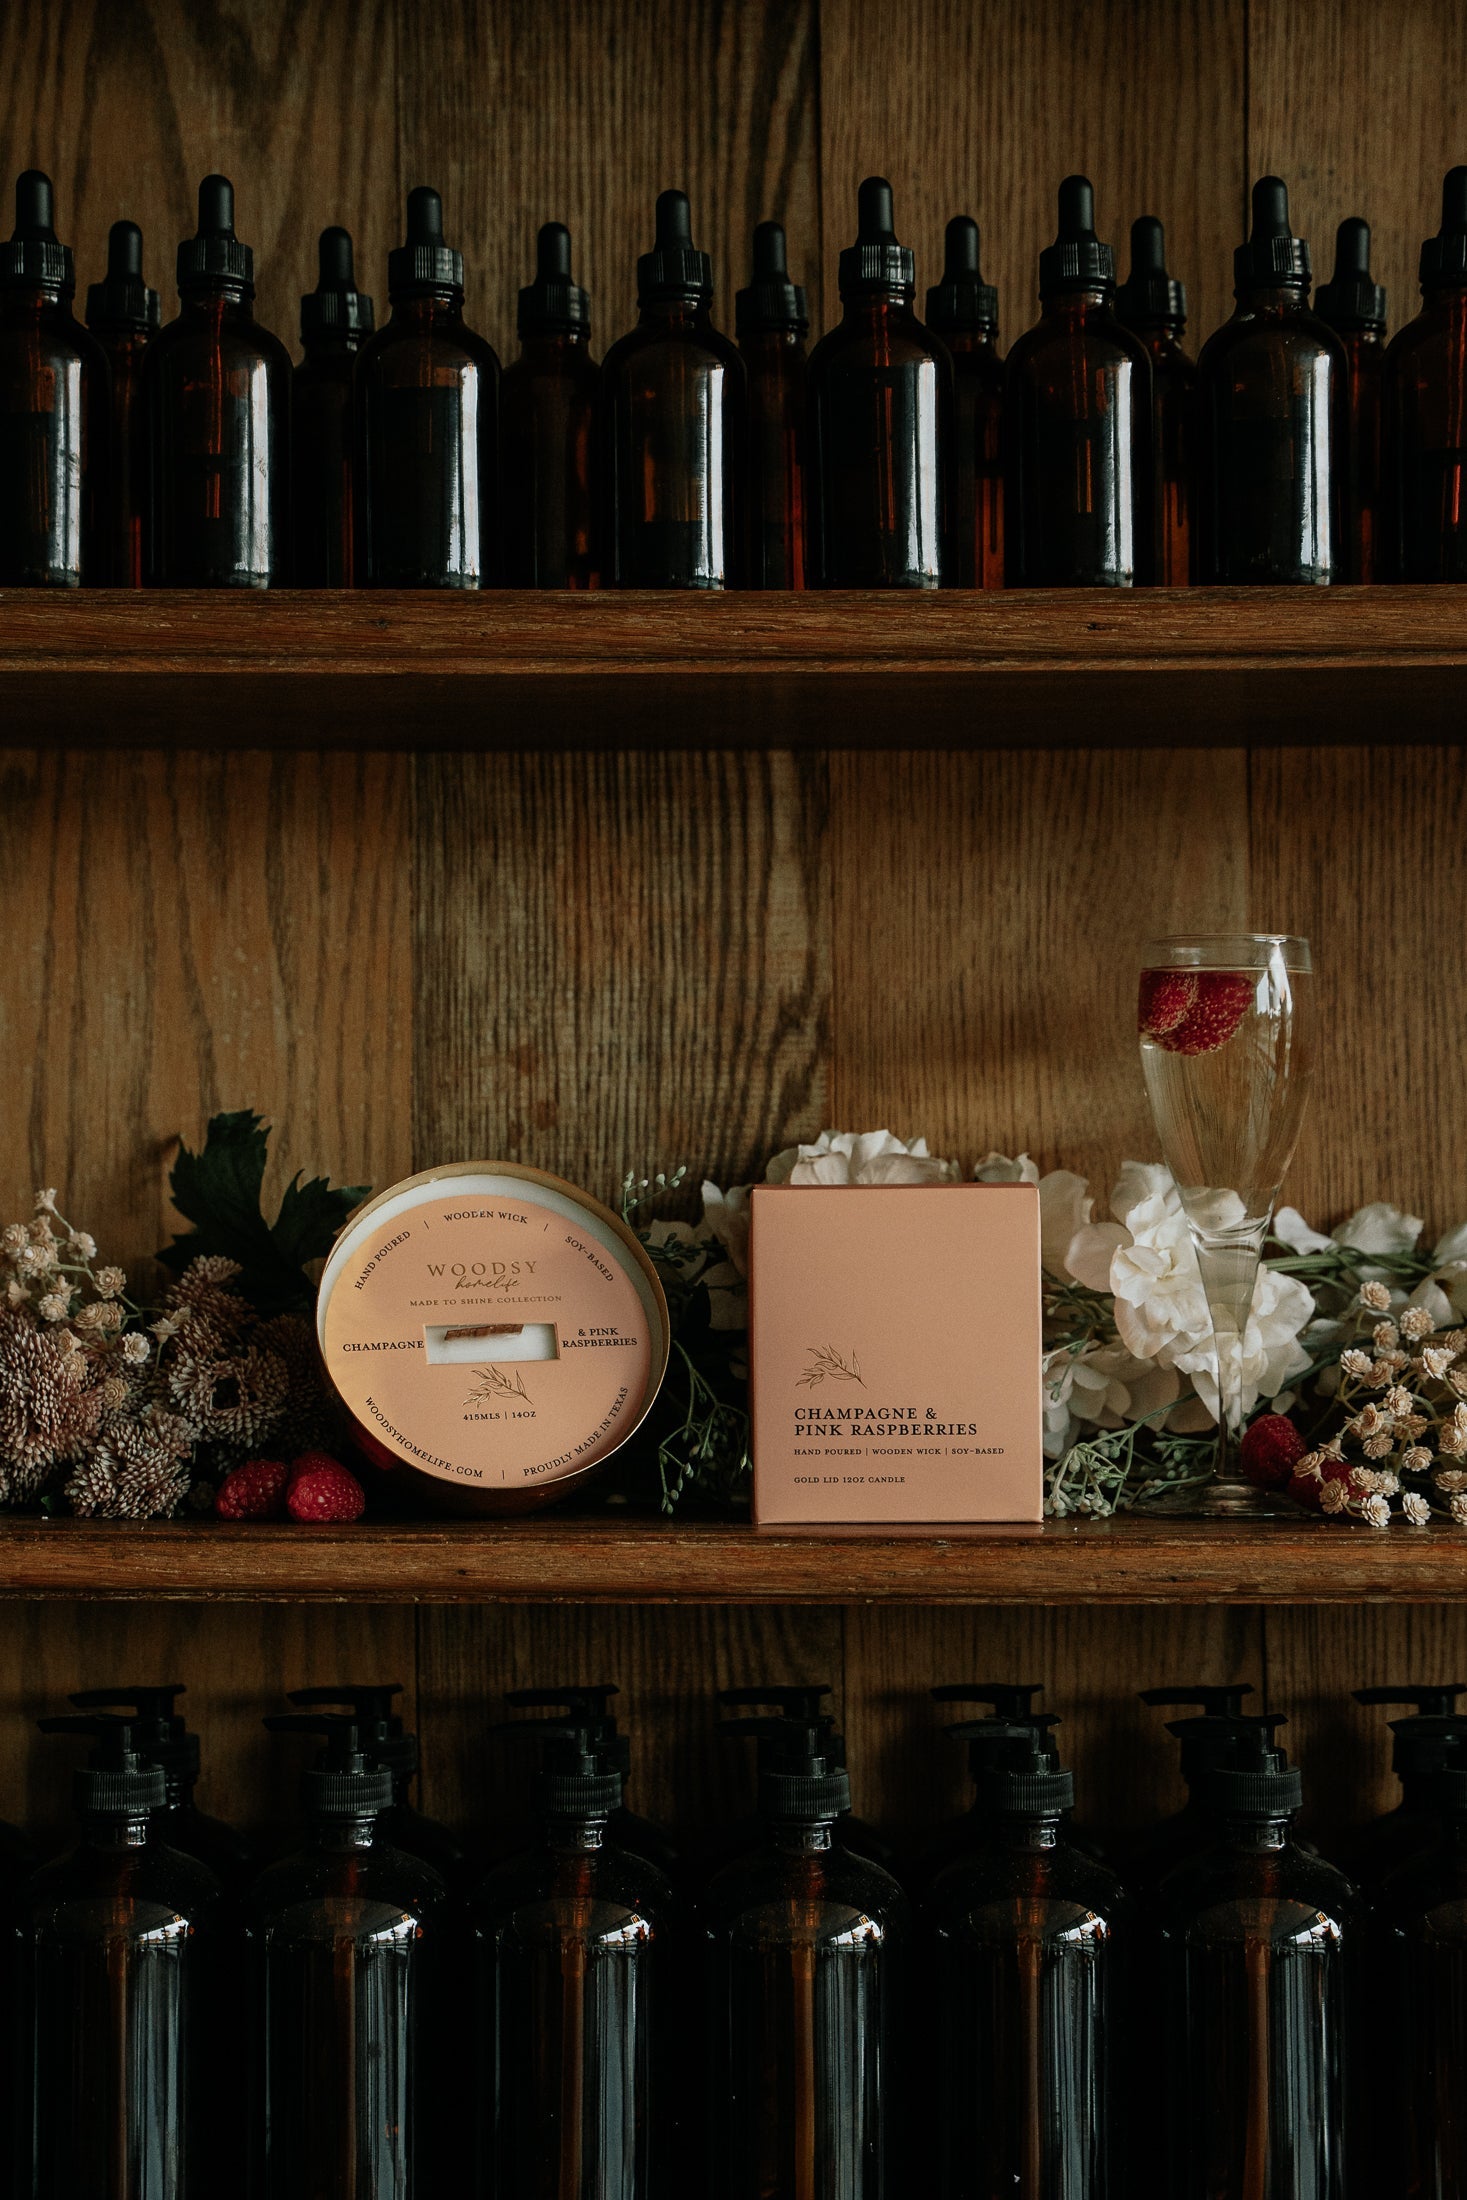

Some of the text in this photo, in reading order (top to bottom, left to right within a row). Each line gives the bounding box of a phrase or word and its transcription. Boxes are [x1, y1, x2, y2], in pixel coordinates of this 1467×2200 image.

[444, 1210, 528, 1224] WOODEN WICK
[355, 1231, 411, 1291] HAND POURED
[564, 1236, 614, 1283] SOY-BASED
[427, 1261, 538, 1277] WOODSY
[455, 1275, 520, 1292] homelife
[410, 1299, 438, 1307] MADE
[460, 1297, 494, 1305] SHINE
[496, 1295, 562, 1303] COLLECTION
[589, 1328, 619, 1336] PINK
[342, 1340, 424, 1352] CHAMPAGNE
[562, 1338, 638, 1348] RASPBERRIES
[463, 1411, 537, 1421] 415MLS 14OZ
[794, 1408, 937, 1420] CHAMPAGNE &
[523, 1386, 629, 1476] PROUDLY MADE IN TEXAS
[794, 1424, 977, 1436] PINK RASPBERRIES
[365, 1396, 483, 1478] WOODSYHOMELIFE.COM
